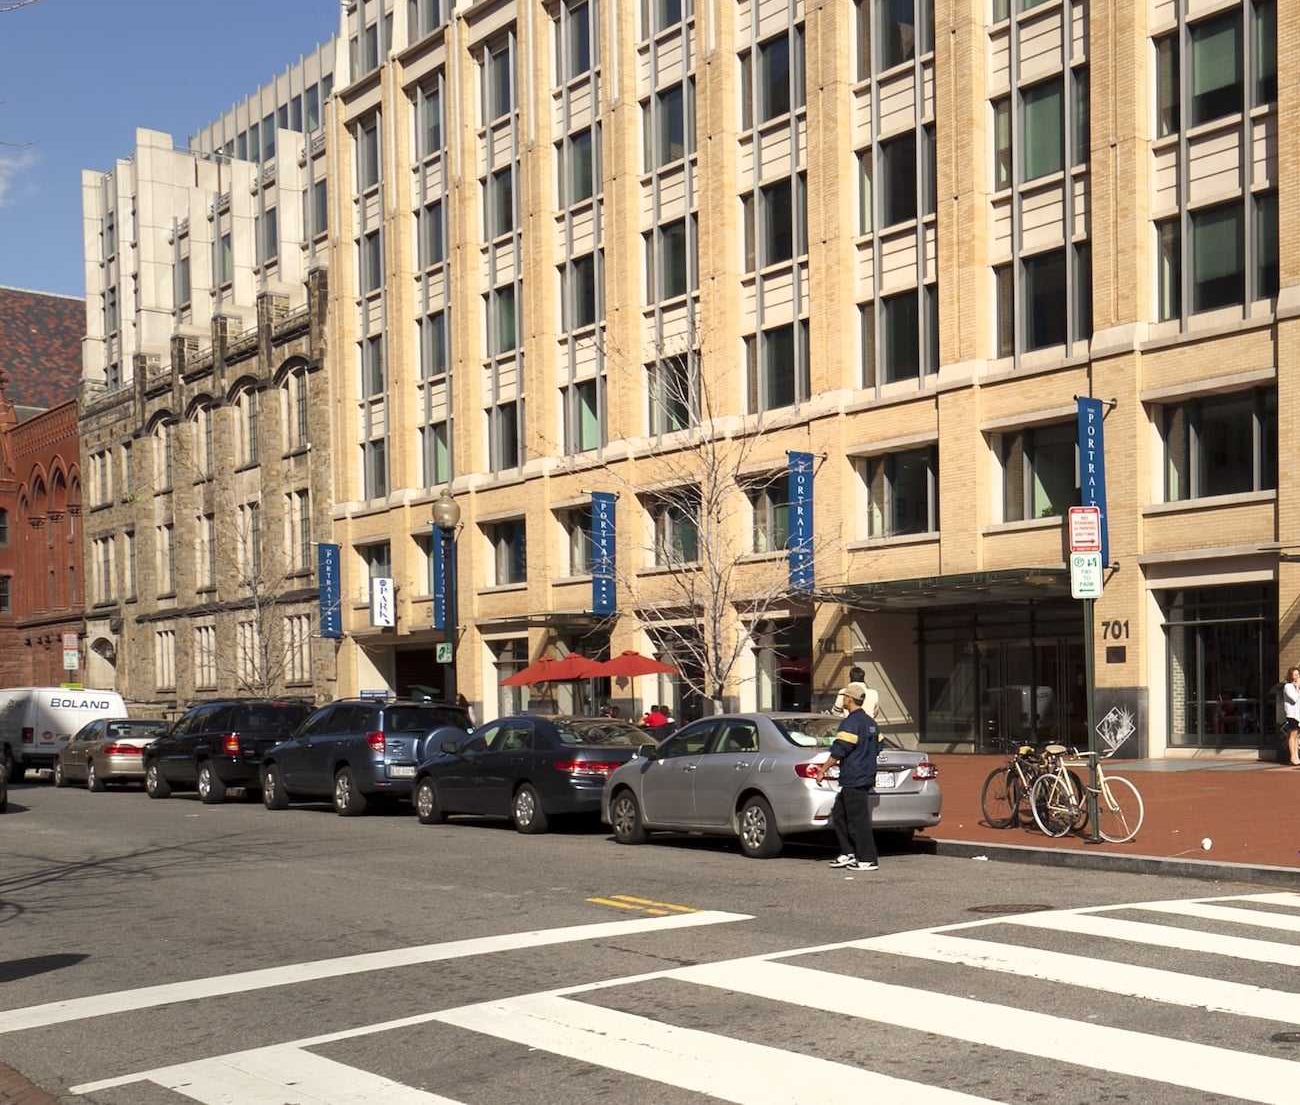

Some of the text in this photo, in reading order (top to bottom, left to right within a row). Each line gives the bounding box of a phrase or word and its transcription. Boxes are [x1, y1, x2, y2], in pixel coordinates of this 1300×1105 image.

[1087, 413, 1096, 507] PORTRAIT
[1101, 620, 1129, 640] 701
[50, 698, 110, 709] BOLAND
